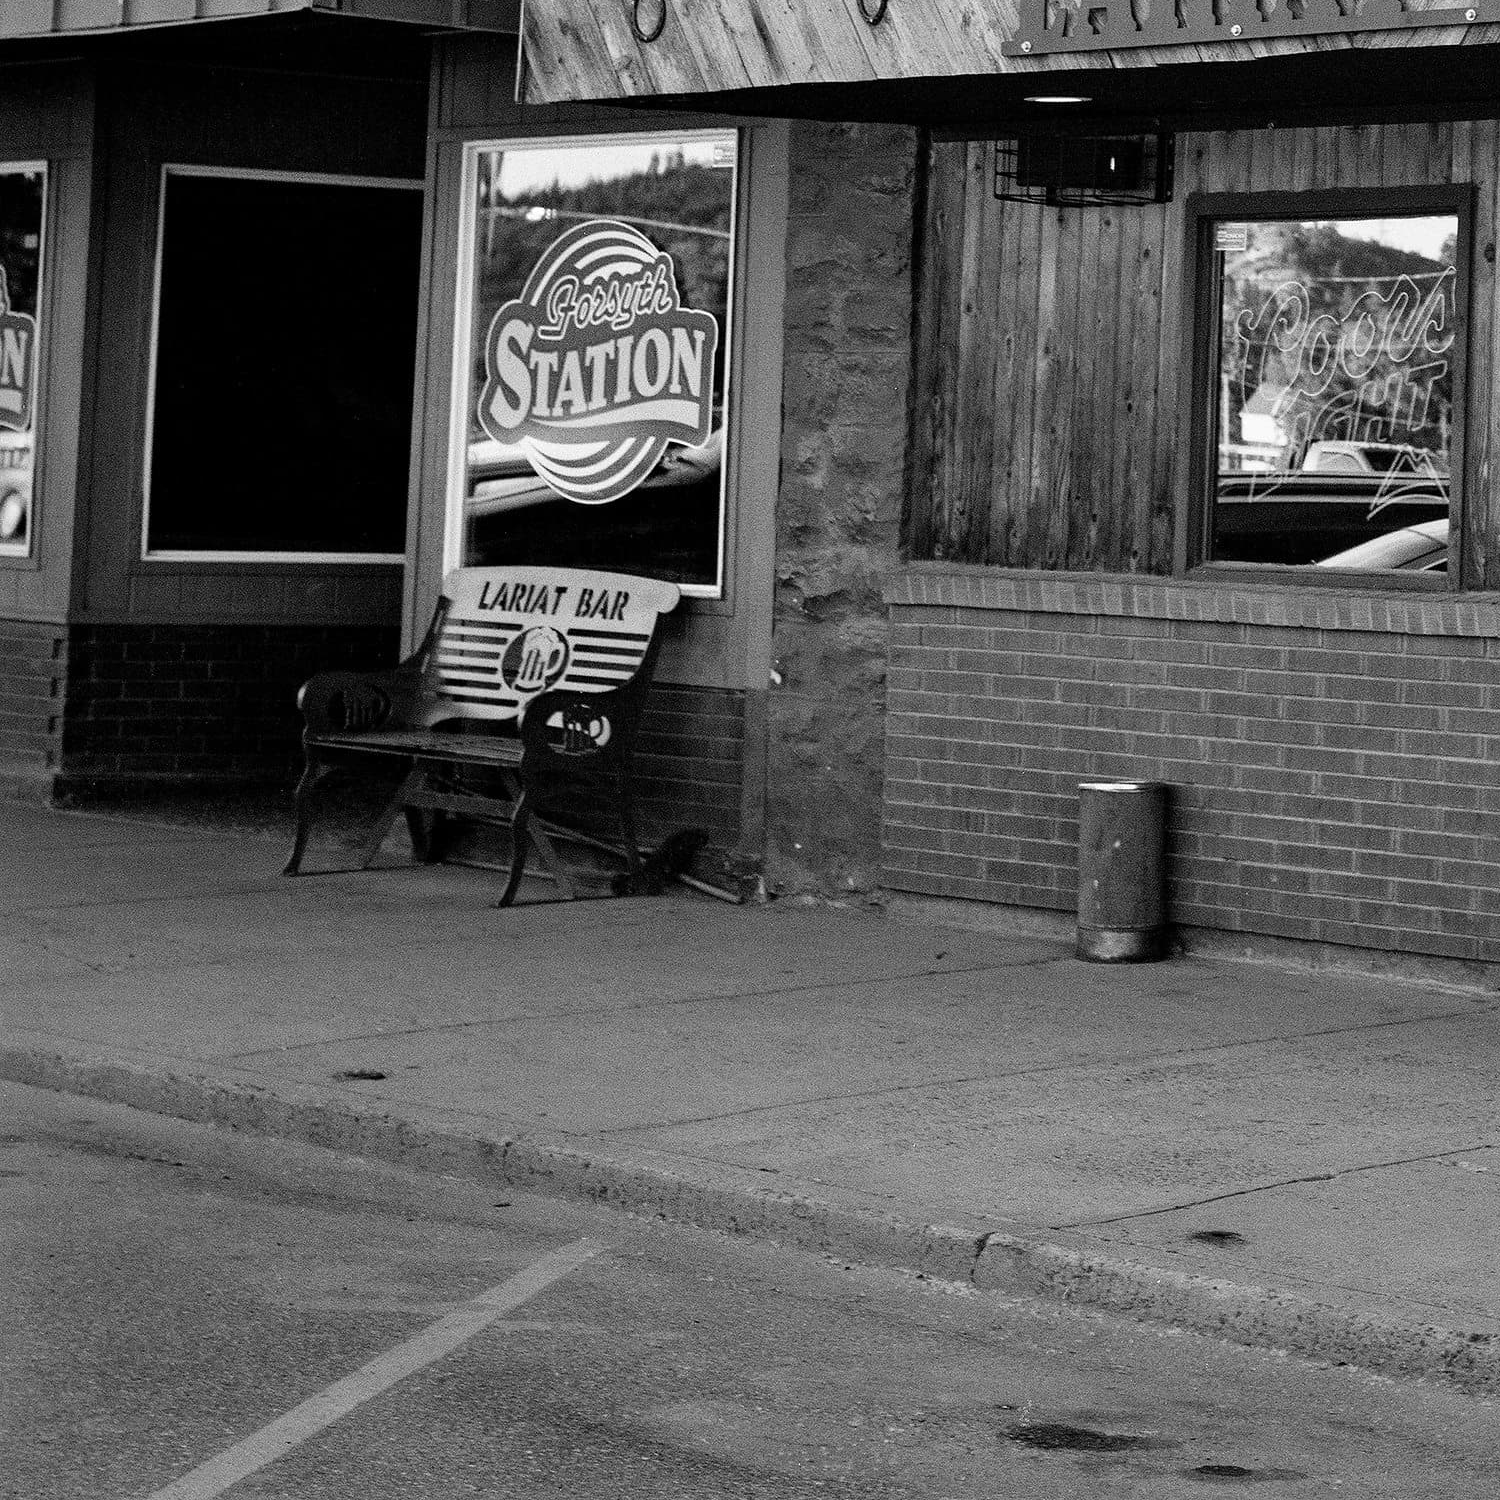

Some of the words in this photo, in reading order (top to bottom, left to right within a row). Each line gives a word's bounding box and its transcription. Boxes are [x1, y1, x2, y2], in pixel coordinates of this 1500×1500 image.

[538, 263, 673, 341] Forsyth
[489, 318, 706, 430] STATION
[478, 580, 568, 616] LARIAT
[575, 587, 630, 621] BAR
